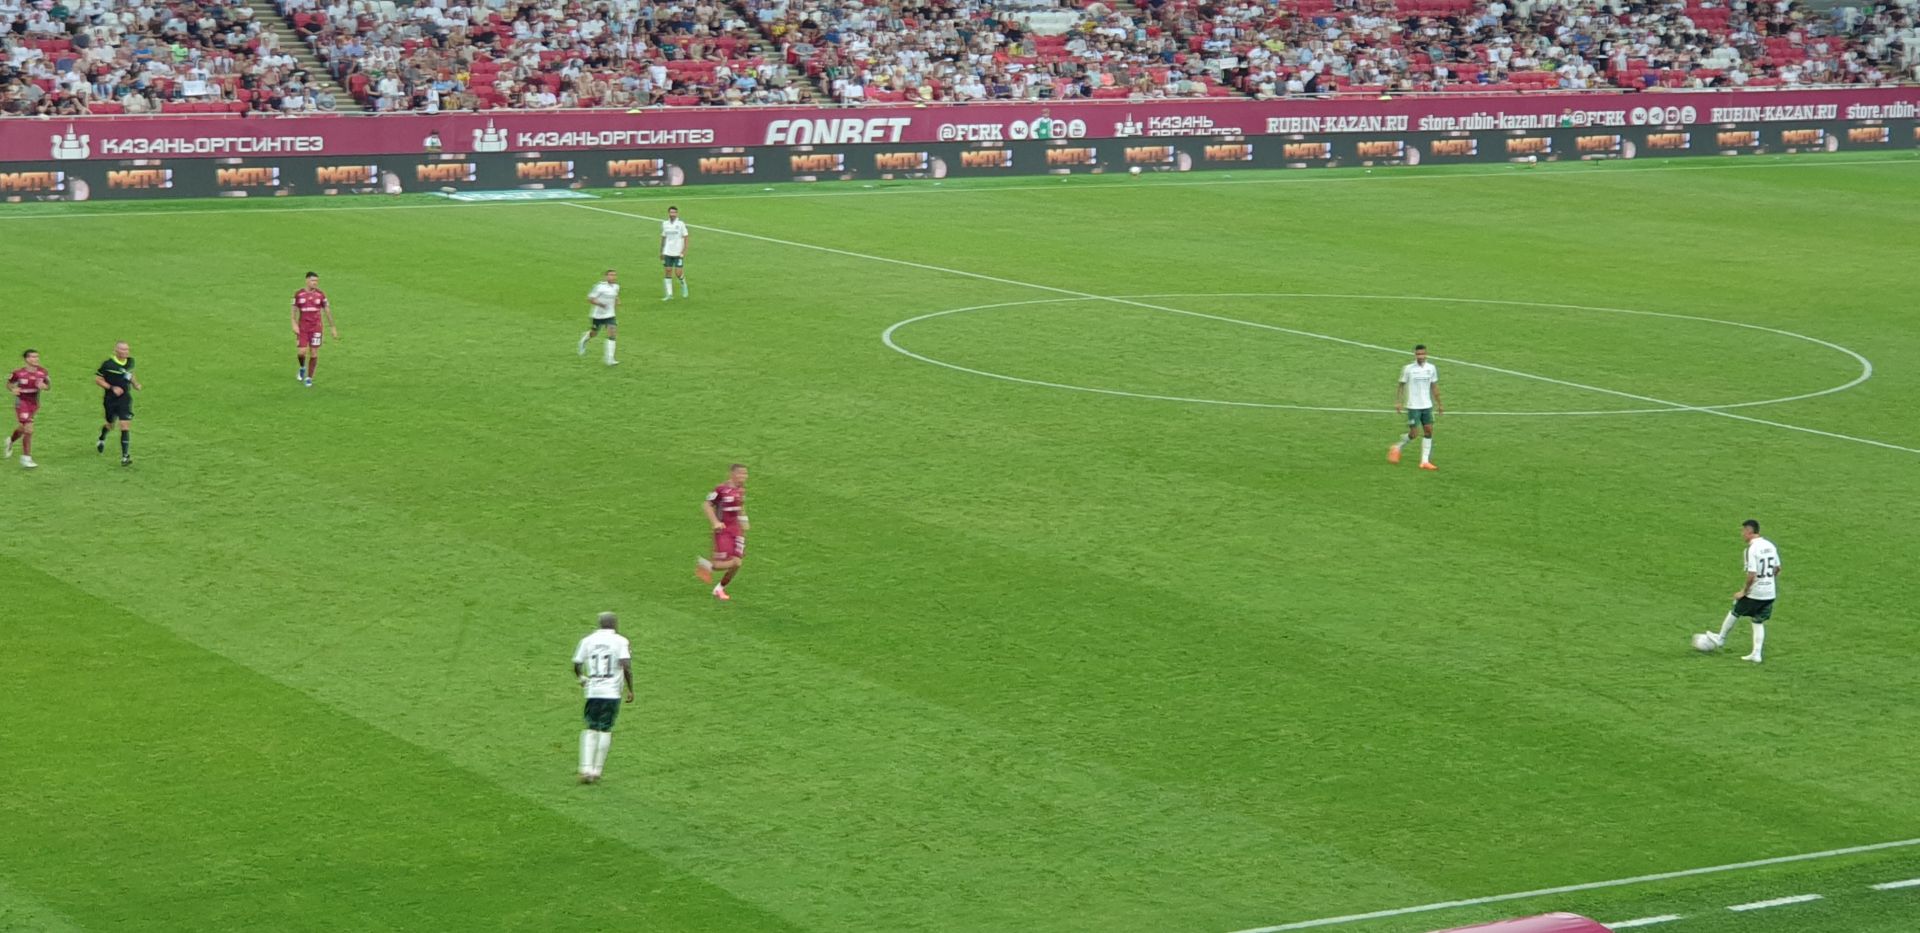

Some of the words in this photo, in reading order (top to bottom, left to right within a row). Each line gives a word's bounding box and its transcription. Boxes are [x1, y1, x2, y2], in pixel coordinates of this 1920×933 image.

[1711, 104, 1838, 122] RUBIN-KAZAN.RU
[1846, 100, 1920, 119] store.rubin-
[1148, 116, 1213, 128] КАЗАНЬ
[1267, 116, 1408, 133] RUBIN-KAZAN.RU
[1419, 112, 1556, 131] store.rubin-kazan.ru
[516, 129, 713, 146] КАЗАНЬОРГСИНТЕЗ
[765, 118, 911, 145] FONBET
[937, 124, 1003, 141] @FCRK
[101, 136, 323, 154] КАЗАНЬОРГСИНТЕЗ
[1756, 556, 1775, 579] 15
[589, 653, 615, 679] 11
